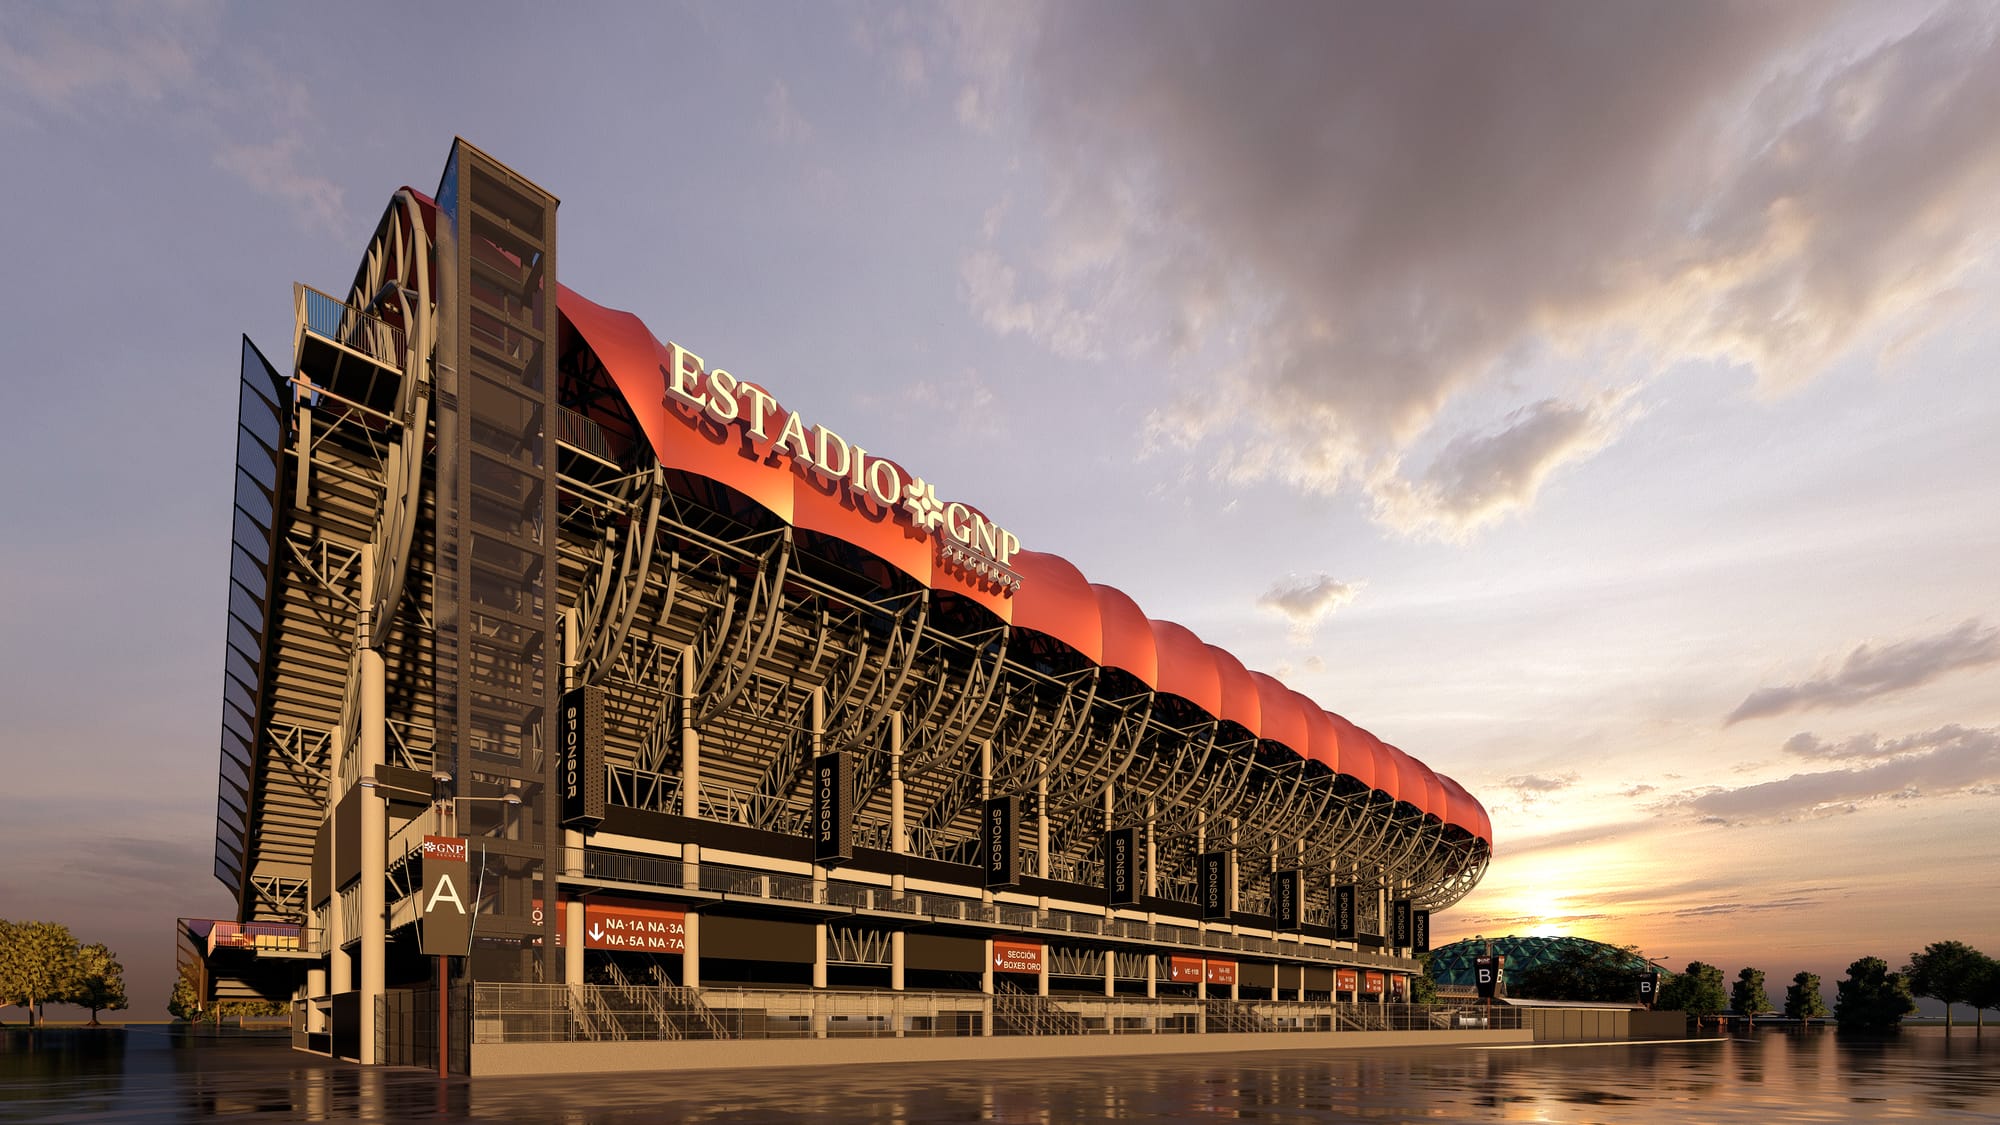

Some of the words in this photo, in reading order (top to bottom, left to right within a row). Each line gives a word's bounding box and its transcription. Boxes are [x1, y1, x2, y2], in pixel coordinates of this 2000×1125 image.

[665, 340, 901, 508] ESTADIO
[943, 502, 1021, 567] GNP
[942, 544, 1021, 592] SEGUROS
[567, 706, 577, 800] SPONSOR
[821, 767, 831, 842] SPONSOR
[436, 843, 464, 854] GNP
[992, 808, 1002, 872] SPONSOR
[1115, 838, 1125, 893] SPONSOR
[1209, 860, 1218, 909] SPONSOR
[425, 873, 466, 915] A
[1282, 878, 1290, 921] SPONSOR
[1340, 891, 1349, 931] SPONSOR
[1397, 905, 1405, 940] SPONSOR
[1003, 961, 1026, 970] BOXES
[1026, 962, 1041, 971] ORO
[1007, 950, 1036, 960] SECCIÓN
[1478, 968, 1491, 984] B
[1641, 981, 1651, 993] B
